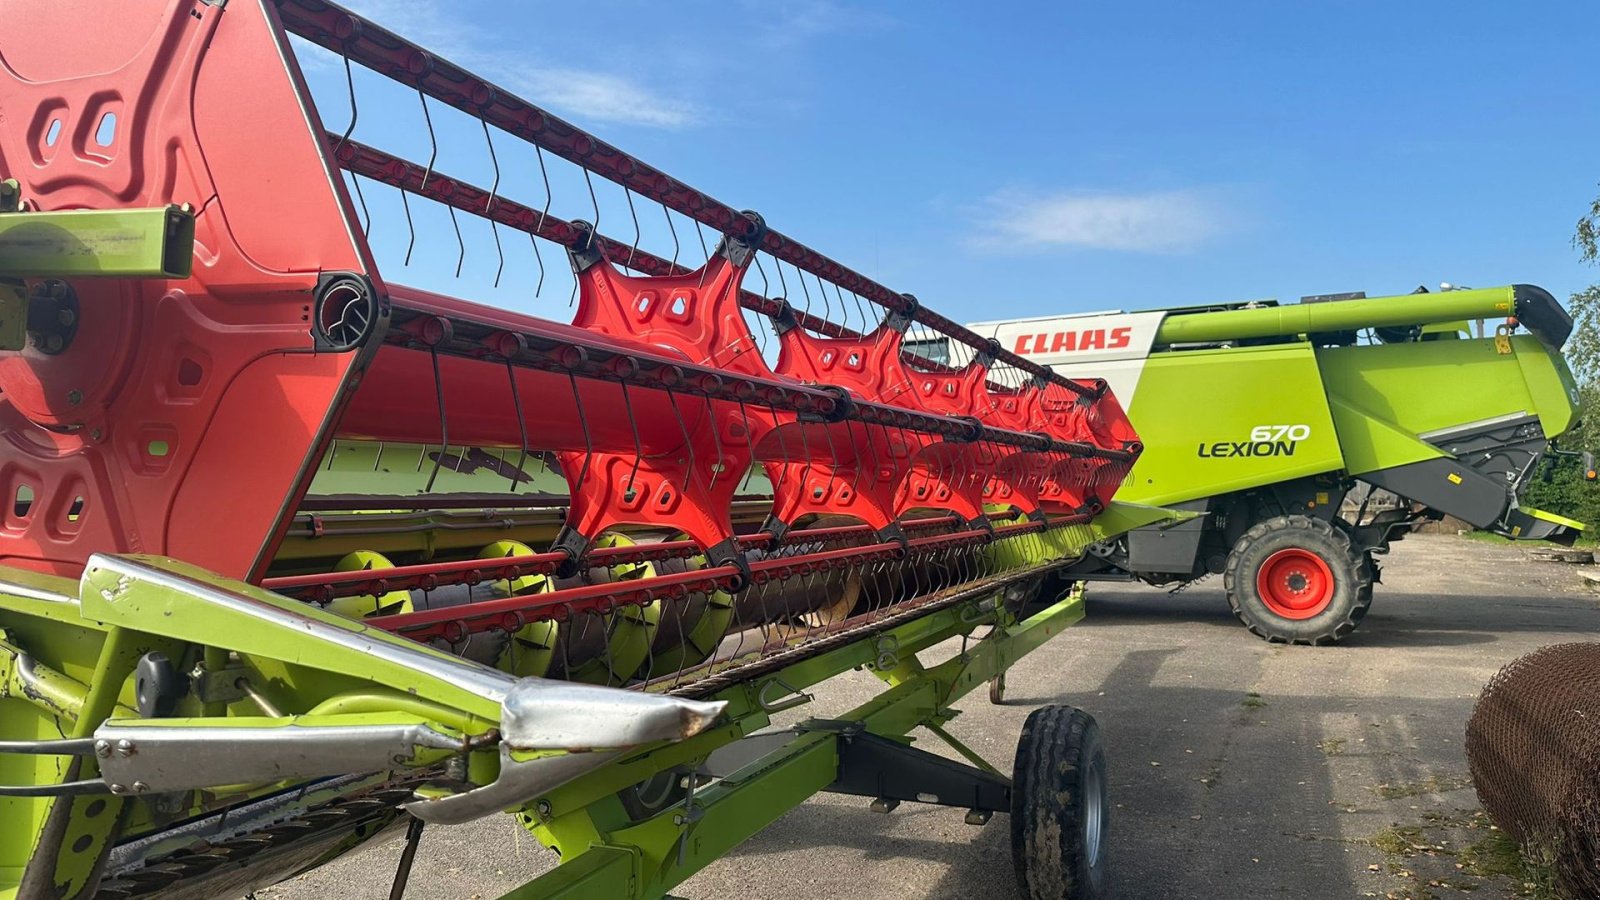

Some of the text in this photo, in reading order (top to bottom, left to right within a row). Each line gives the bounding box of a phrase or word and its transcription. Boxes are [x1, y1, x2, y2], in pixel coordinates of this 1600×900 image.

[1014, 327, 1132, 354] CLAAS
[1250, 424, 1310, 442] 670
[1198, 440, 1296, 458] LEXION
